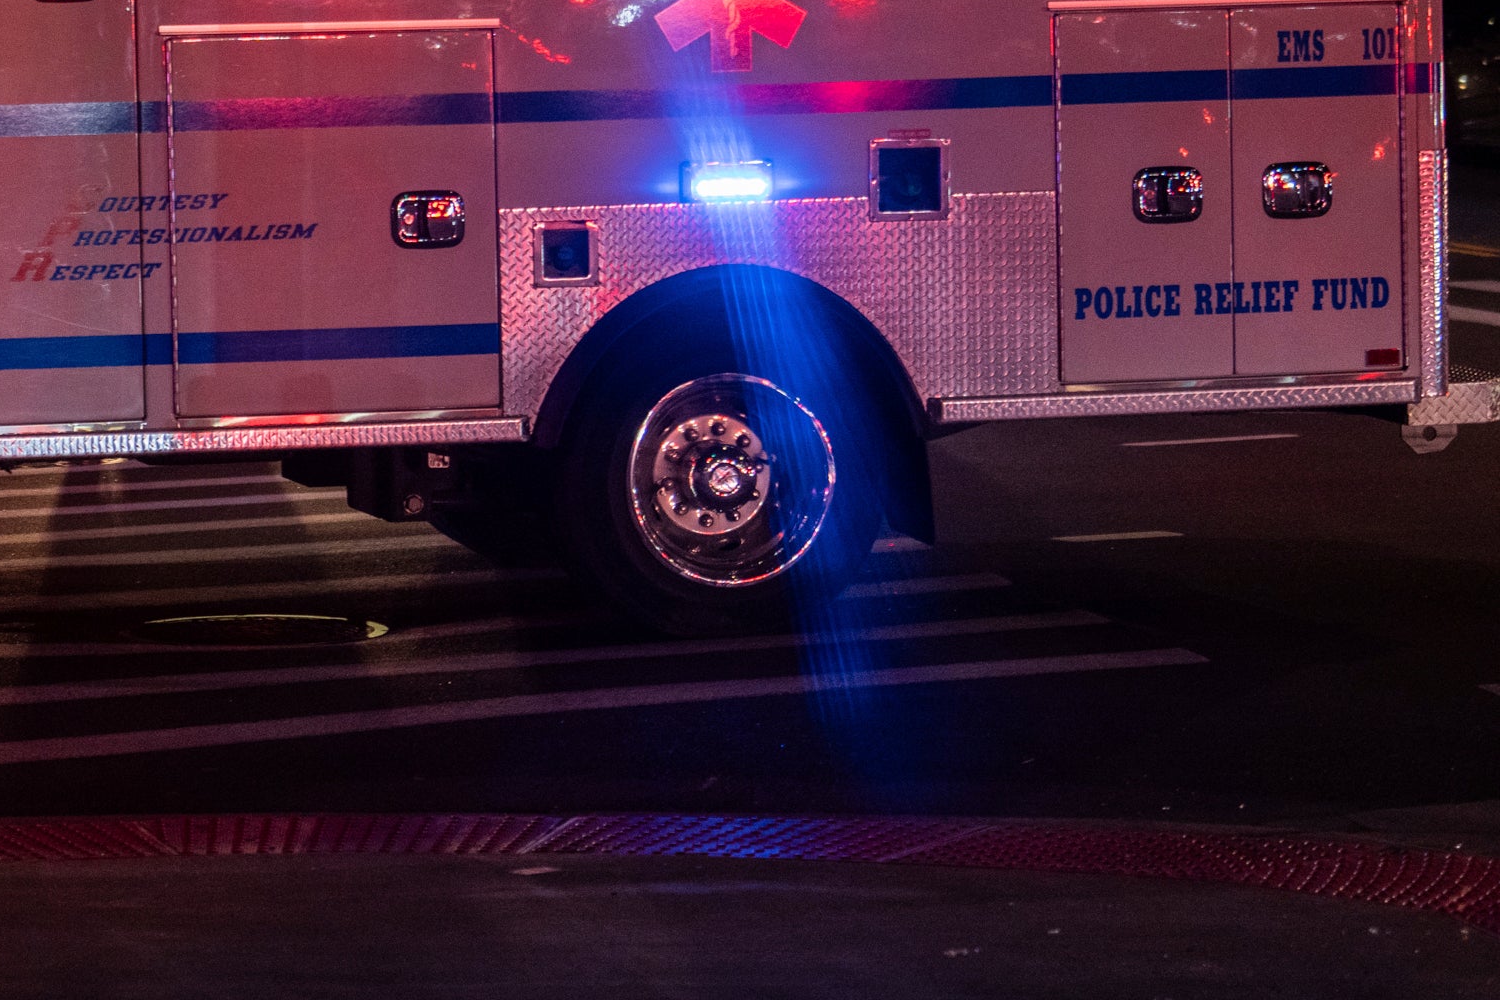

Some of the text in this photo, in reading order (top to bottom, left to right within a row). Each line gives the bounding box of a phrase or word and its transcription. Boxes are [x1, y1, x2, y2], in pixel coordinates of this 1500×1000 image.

[1276, 27, 1397, 63] EMS 101
[9, 251, 162, 283] RESPECT
[1074, 276, 1391, 320] POLICE RELIEF FUND
